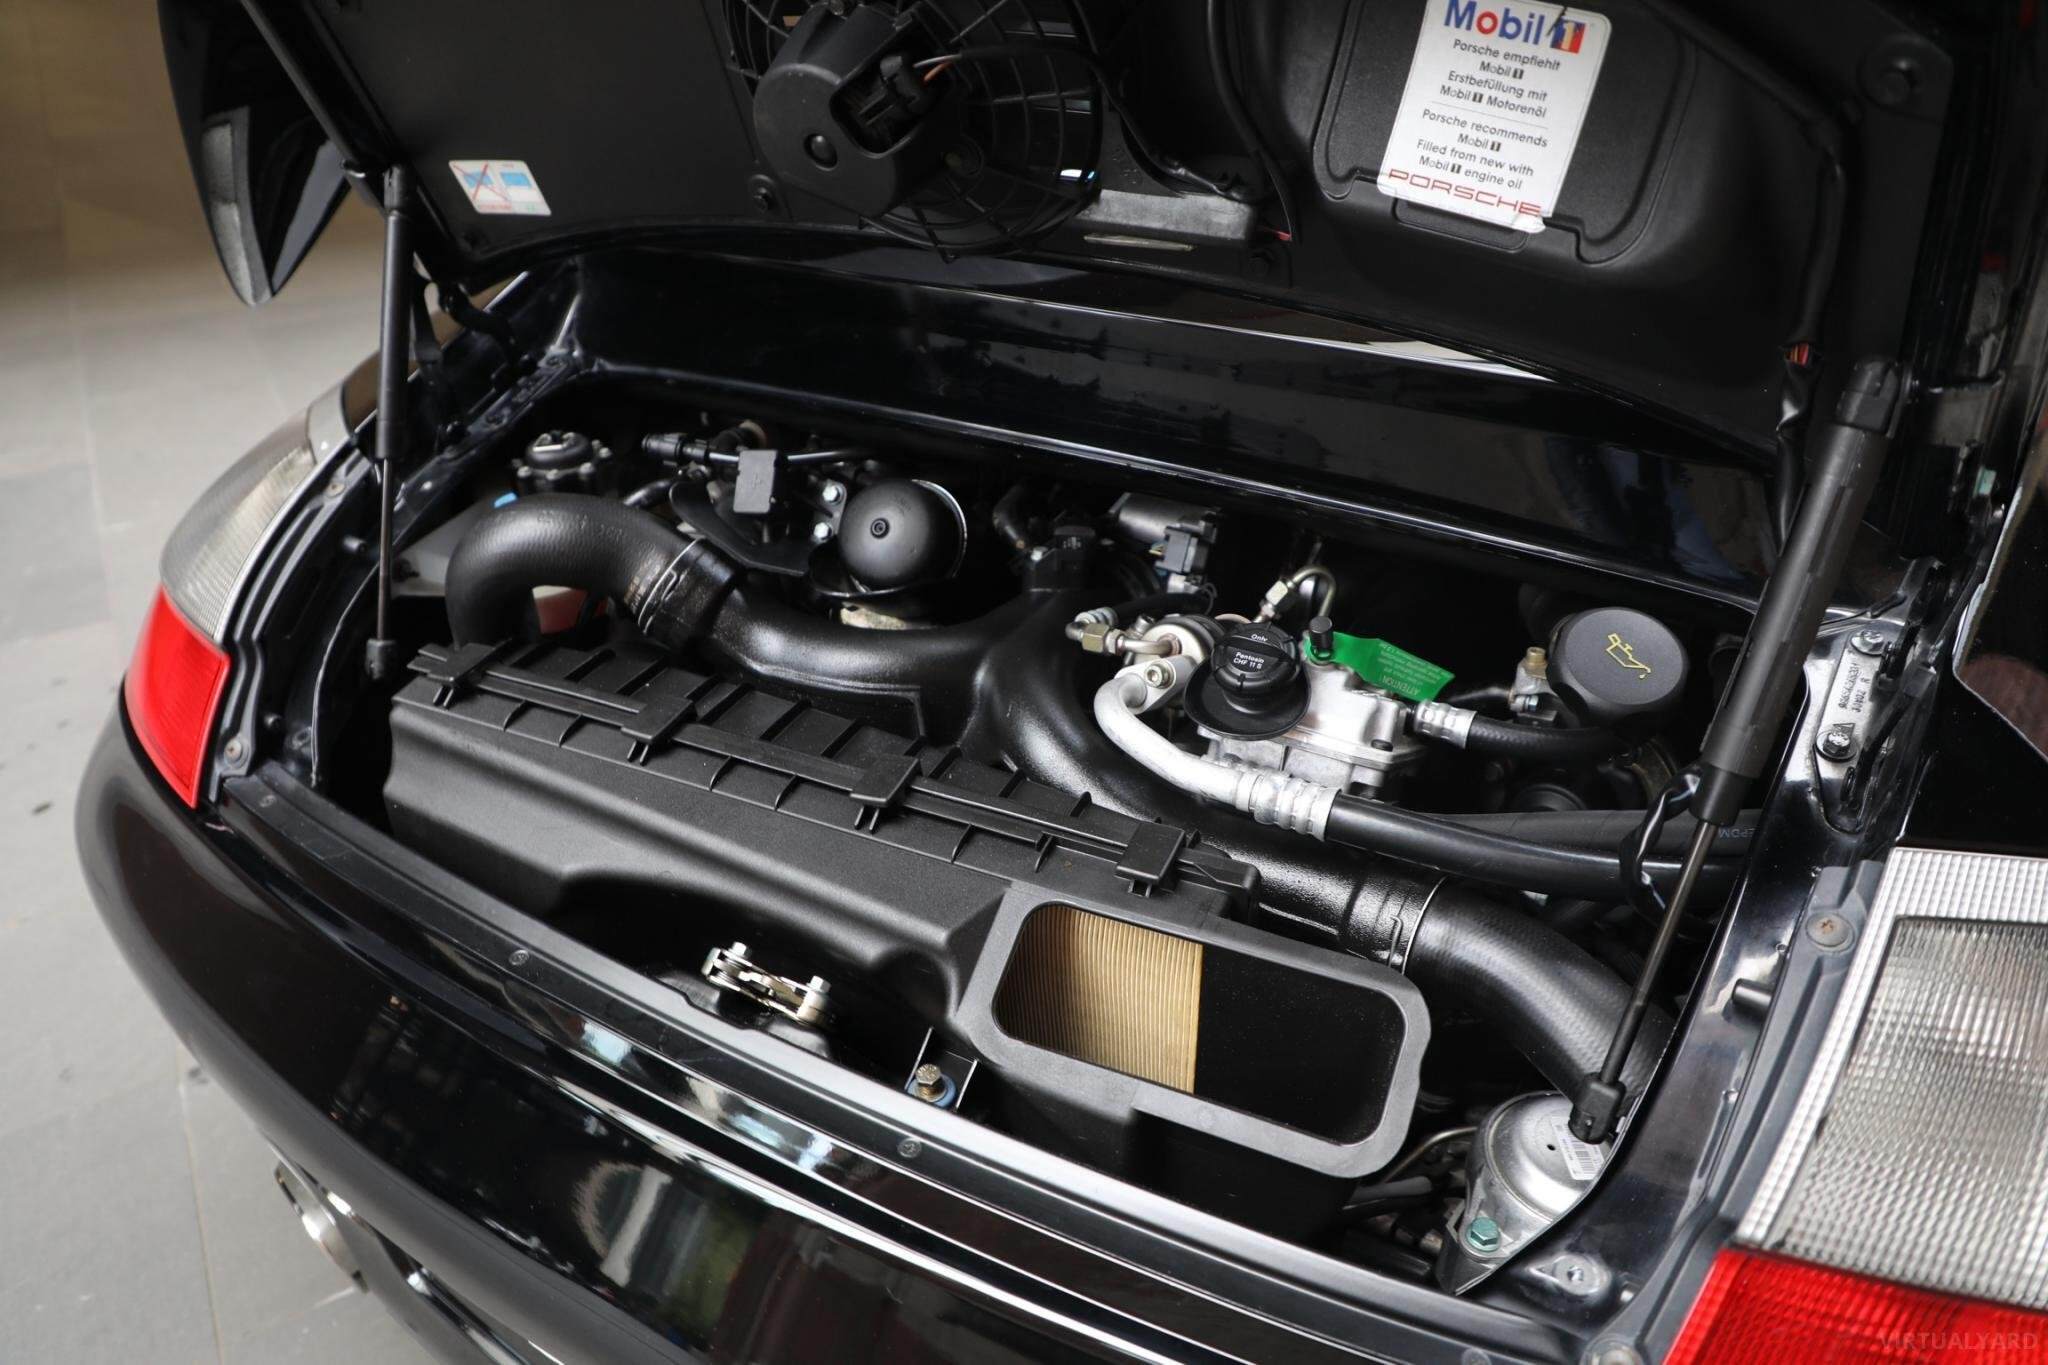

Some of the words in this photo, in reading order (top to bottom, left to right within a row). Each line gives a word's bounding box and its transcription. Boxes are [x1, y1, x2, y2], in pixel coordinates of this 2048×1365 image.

[1444, 0, 1545, 45] Mobil
[1453, 39, 1500, 58] Porsche
[1503, 51, 1560, 71] empfiehlt
[1479, 61, 1512, 77] Mobil
[1440, 85, 1471, 101] Mobil
[1486, 96, 1548, 118] Motorenöl
[1448, 70, 1524, 98] Erstbefüllung
[1528, 89, 1548, 101] mit
[1422, 108, 1468, 128] Porsche
[1470, 121, 1548, 148] recommends
[1457, 133, 1490, 150] Mobil
[1417, 139, 1447, 155] Filled
[1450, 147, 1477, 163] from
[1479, 157, 1505, 169] new
[1508, 162, 1534, 177] with
[1419, 155, 1450, 171] Mobil
[1464, 167, 1504, 185] engine
[1507, 179, 1523, 190] oil
[1388, 168, 1541, 218] PORSCHE
[1250, 633, 1268, 643] Only
[1235, 651, 1265, 664] Pentosin
